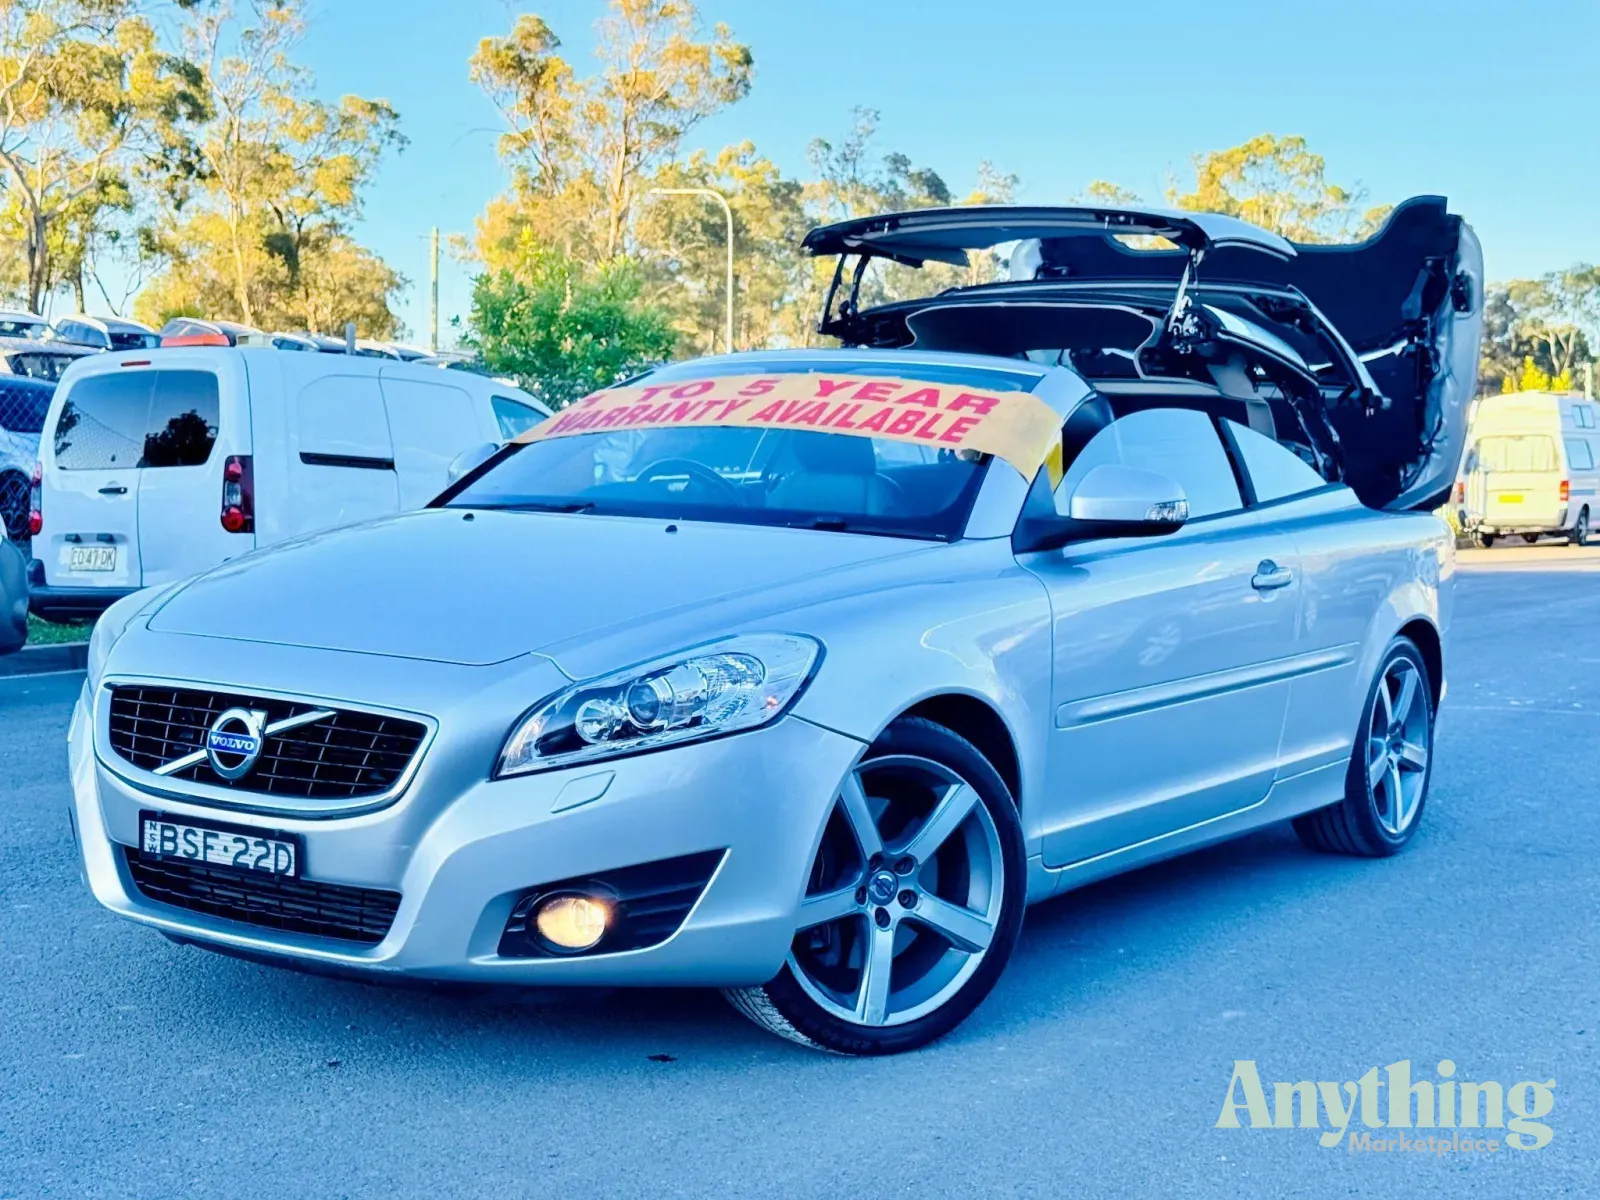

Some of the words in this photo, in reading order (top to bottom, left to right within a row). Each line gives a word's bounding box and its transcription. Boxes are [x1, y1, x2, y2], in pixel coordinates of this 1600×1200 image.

[636, 381, 716, 402] TO
[738, 379, 780, 396] 5
[815, 379, 1001, 416] YEAR
[544, 399, 752, 435] WARRANTY
[747, 399, 983, 444] AVAILABLE
[211, 735, 255, 751] VOLVO
